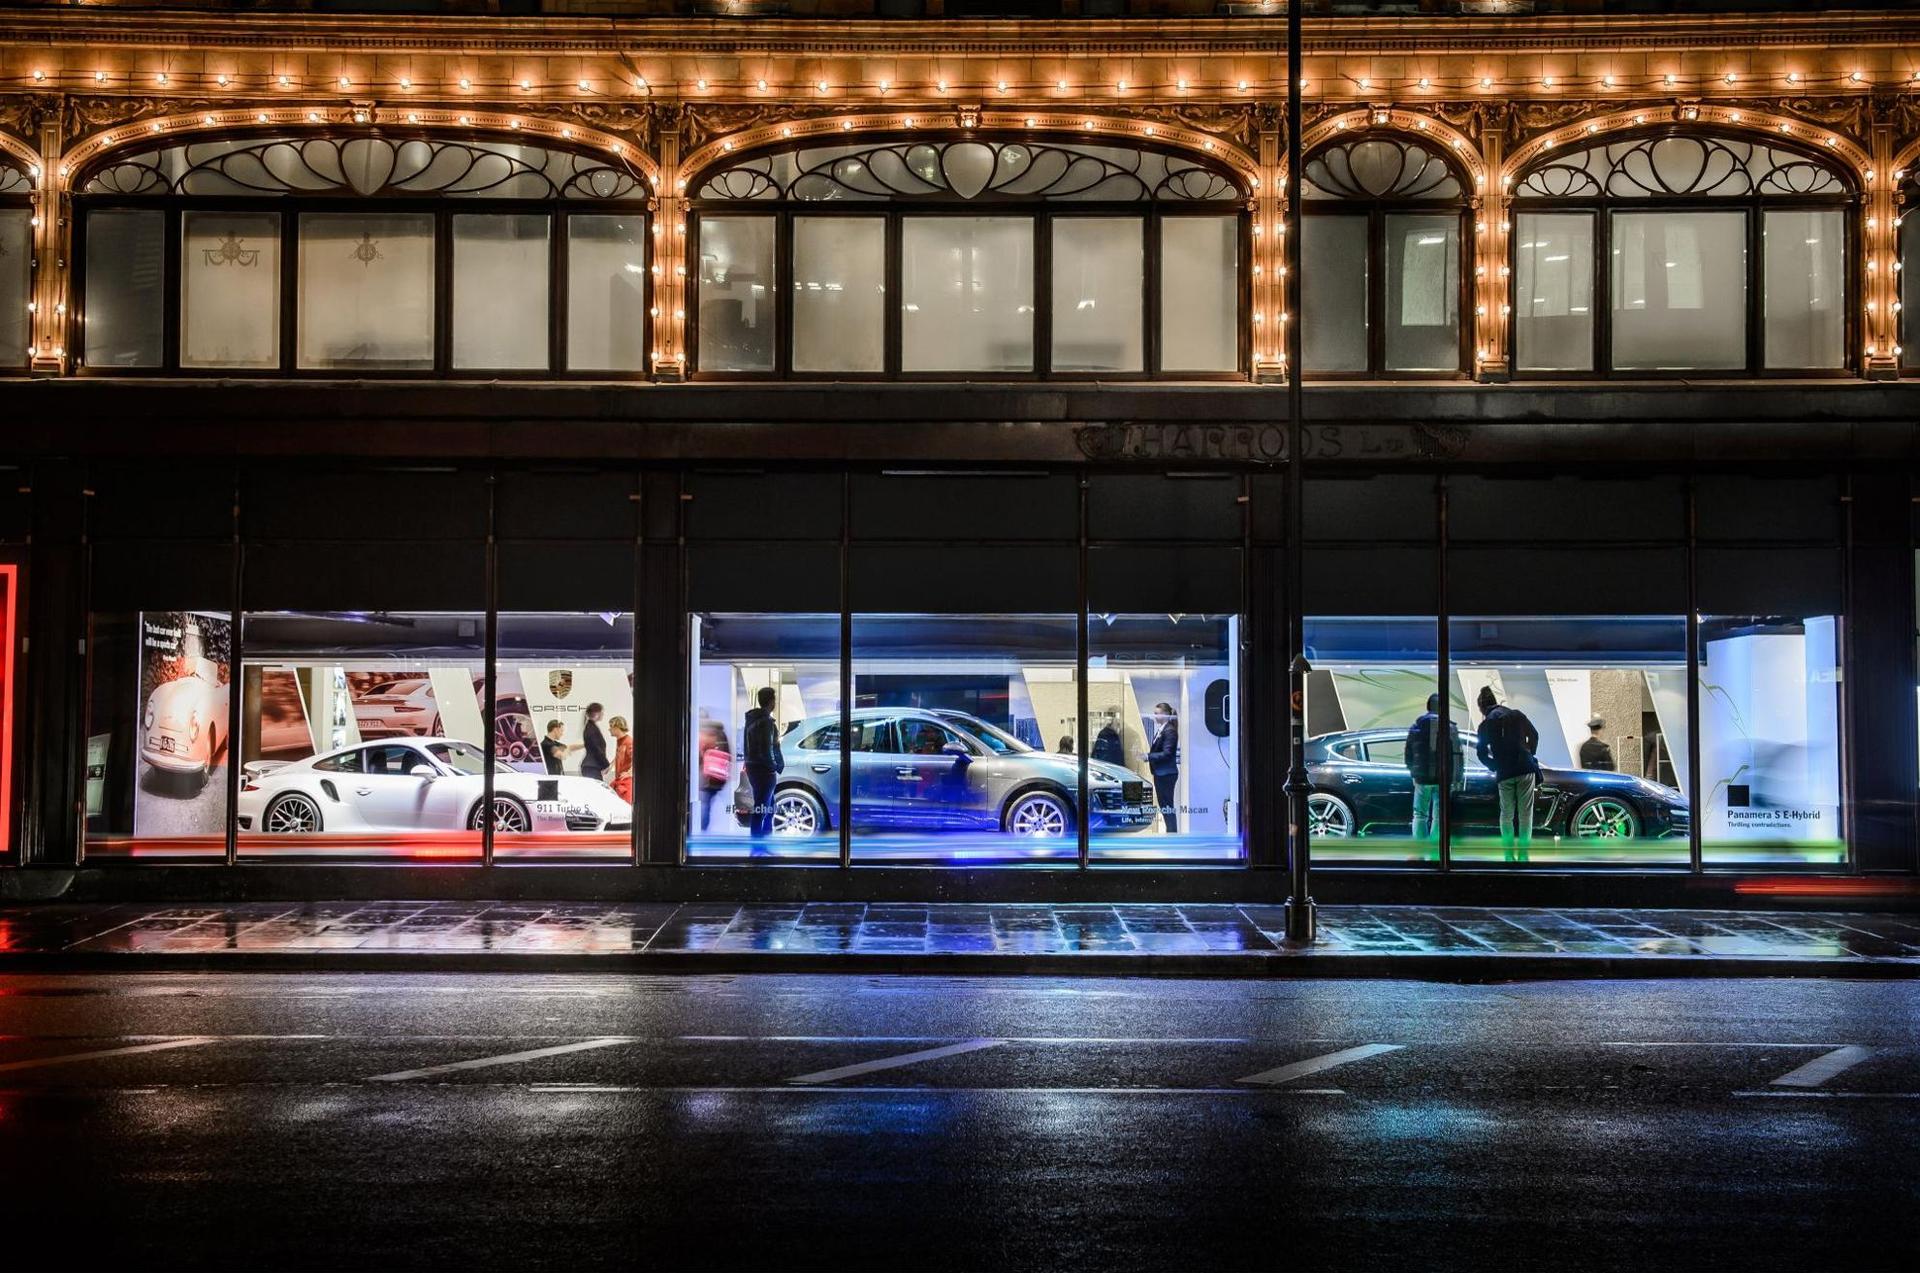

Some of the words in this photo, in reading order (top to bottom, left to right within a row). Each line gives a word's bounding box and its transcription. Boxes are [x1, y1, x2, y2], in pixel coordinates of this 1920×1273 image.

[529, 704, 589, 713] ORSCH
[537, 803, 553, 813] 911
[557, 803, 582, 813] Turbo
[584, 803, 590, 812] S
[1179, 805, 1209, 814] Macan
[1727, 810, 1772, 819] Panamera
[1774, 810, 1780, 819] S
[1783, 810, 1820, 821] E-Hybrid
[1727, 821, 1750, 829] Thrilling
